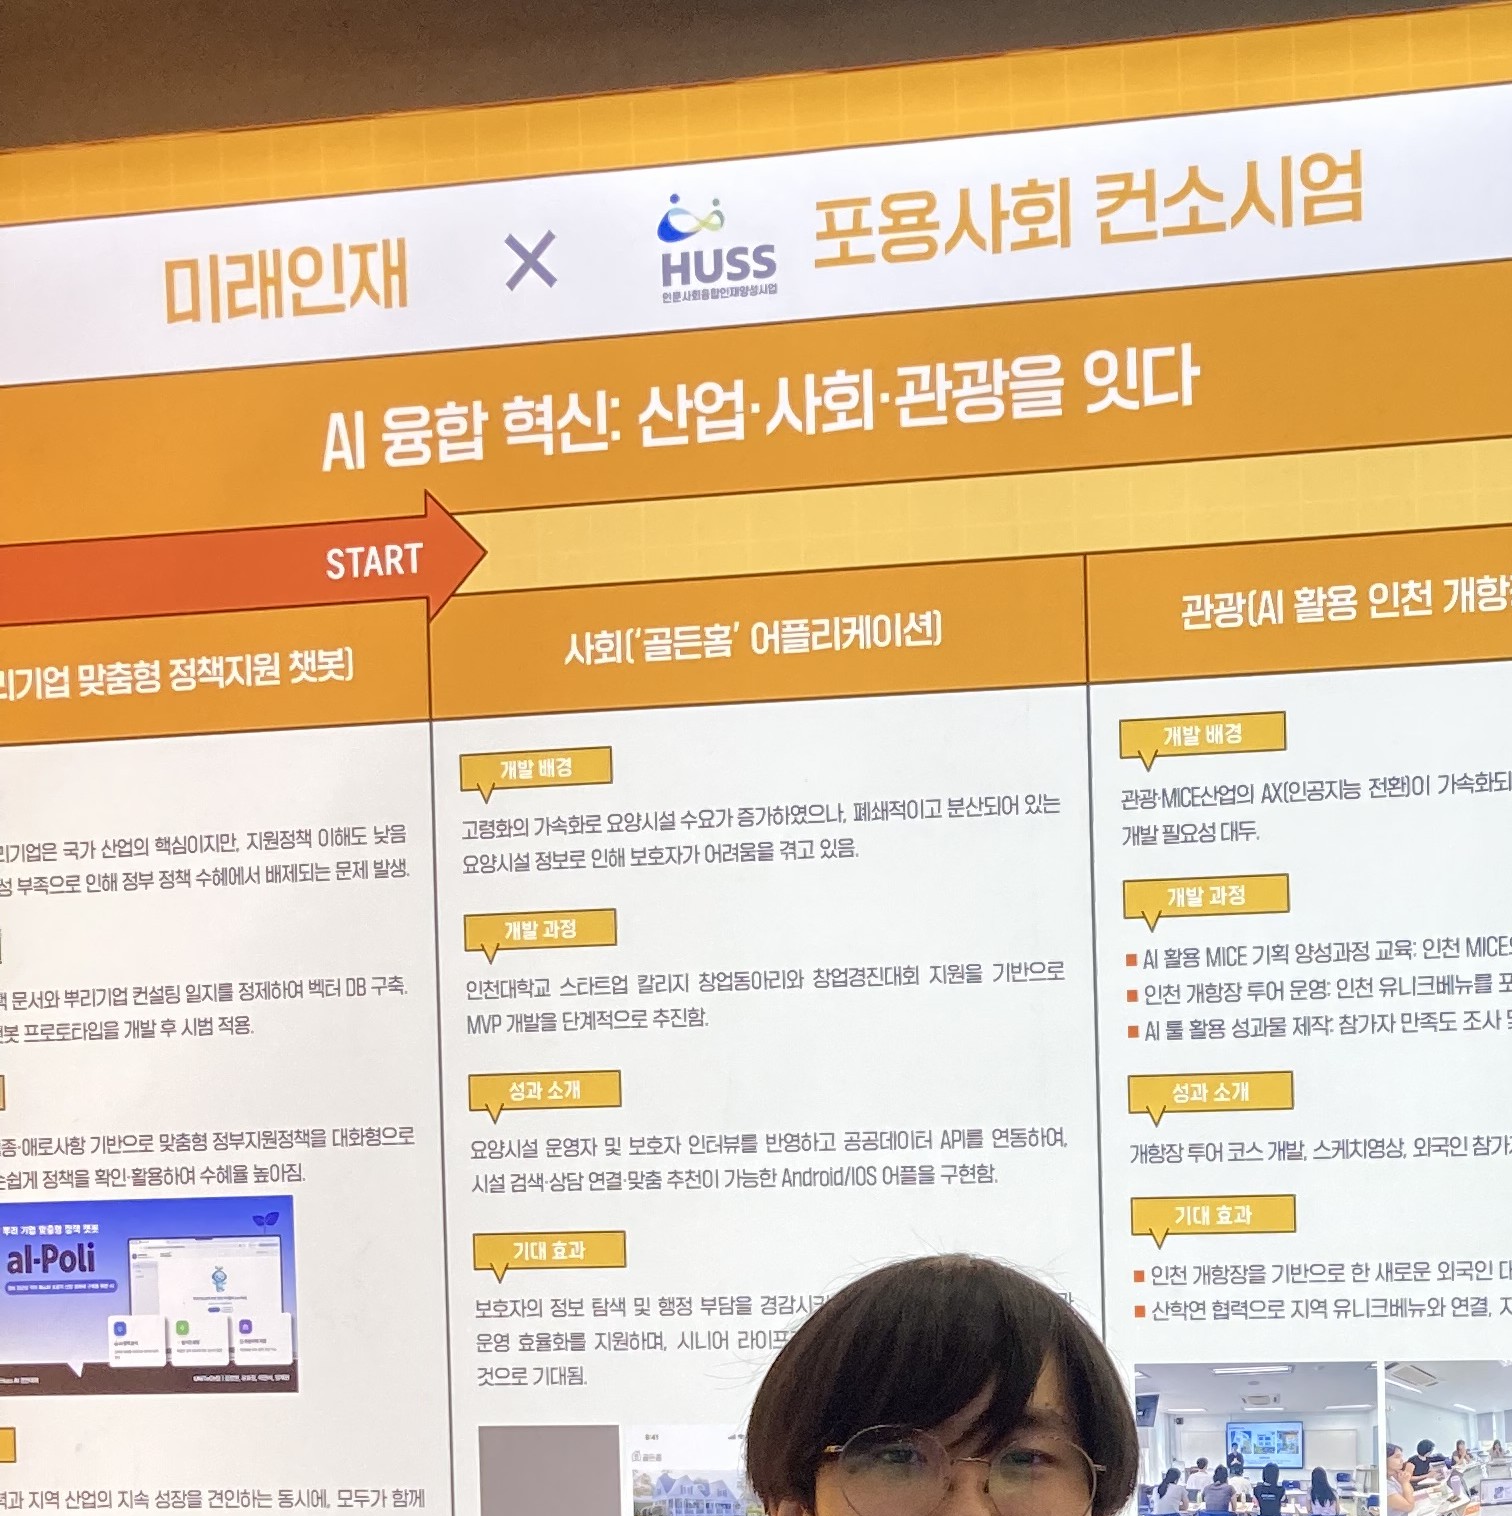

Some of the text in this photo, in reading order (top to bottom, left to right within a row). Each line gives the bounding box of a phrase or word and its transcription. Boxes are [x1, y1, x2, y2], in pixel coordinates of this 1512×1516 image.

[814, 149, 1364, 268] 포용사회 컨소시엄
[661, 243, 778, 287] HUSS
[165, 237, 407, 324] 미래인재
[323, 411, 365, 472] AI
[382, 400, 488, 468] 융합
[1084, 342, 1200, 413] 잇다
[327, 542, 423, 580] START
[1294, 585, 1357, 623] 활용
[1369, 579, 1432, 619] 인천
[78, 660, 160, 696] 맞춤형
[170, 652, 280, 692] 정책지원
[1163, 722, 1243, 748] 개발 배경
[501, 757, 573, 780] 개발 배경
[462, 818, 528, 840] 고령화의
[534, 814, 602, 837] 가속화로
[607, 810, 675, 833] 요양시설
[681, 808, 733, 830] 수요가
[948, 794, 1018, 818] 분산되어
[1025, 793, 1060, 815] 있는
[1122, 824, 1159, 846] 개발
[1163, 821, 1215, 845] 필요성
[1167, 884, 1247, 909] 개발 과정
[505, 919, 576, 941] 개발 과정
[510, 1080, 580, 1101] 성과 소개
[1173, 1082, 1249, 1103] 성과 소개
[1129, 1142, 1184, 1165] 개항장
[1187, 1141, 1223, 1163] 투어
[1228, 1141, 1263, 1162] 코스
[1413, 1135, 1467, 1158] 외국인
[43, 1168, 90, 1190] 정책을
[200, 1164, 249, 1187] 수혜율
[1176, 1205, 1252, 1225] 기대 효과
[513, 1240, 586, 1263] 기대 효과
